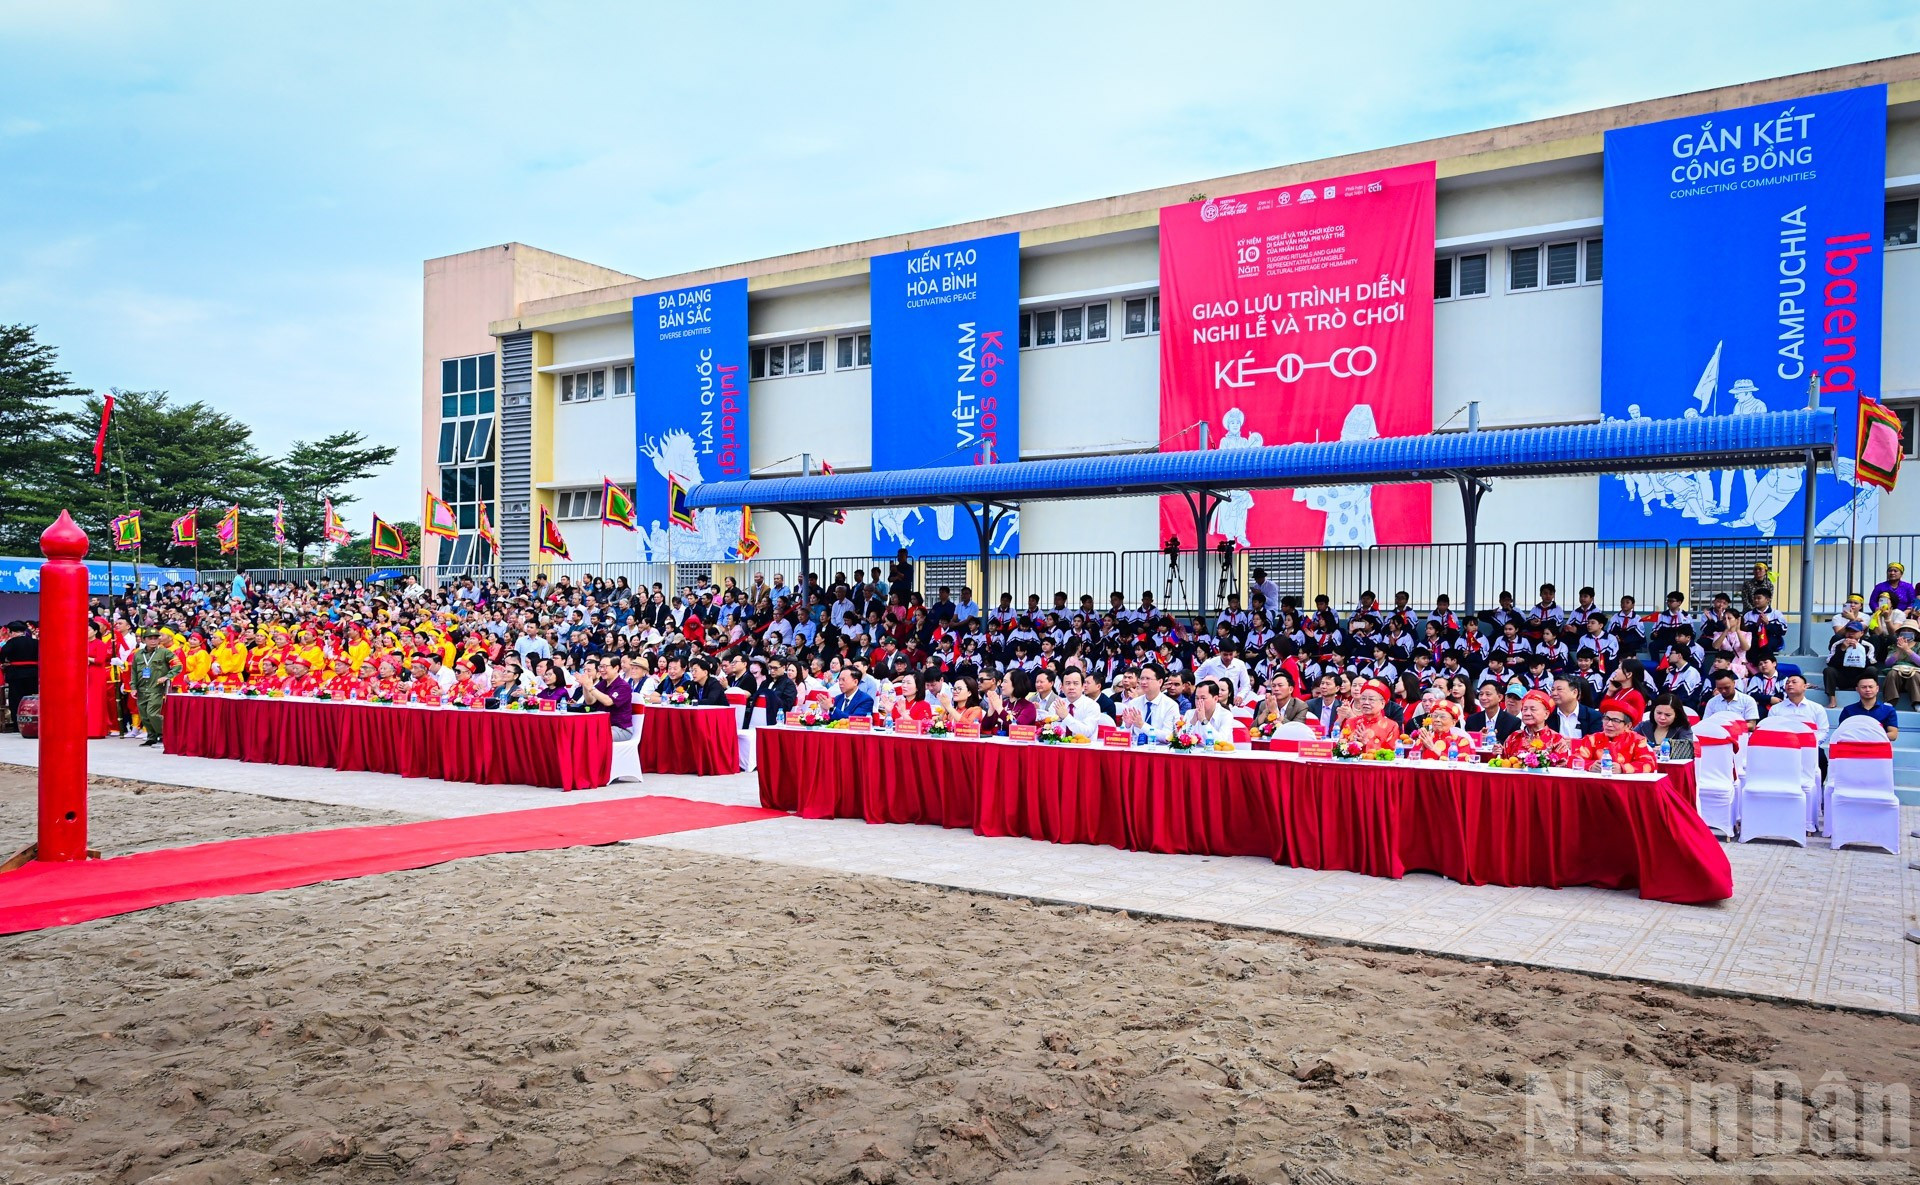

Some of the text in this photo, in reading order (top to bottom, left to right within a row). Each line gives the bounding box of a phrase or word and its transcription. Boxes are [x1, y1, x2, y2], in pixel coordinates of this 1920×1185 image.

[1672, 106, 1816, 159] GẮN KẾT
[1671, 145, 1813, 185] CỘNG ĐỒNG
[1669, 170, 1817, 199] CONNECTING COMMUNITIES
[907, 248, 977, 275] KIẾN TẠO
[1237, 246, 1260, 265] 10
[1266, 267, 1293, 276] CULTURAL
[1294, 263, 1320, 272] HERITAGE
[1329, 258, 1359, 268] HUMANITY
[1290, 251, 1313, 260] RITUALS
[1313, 249, 1325, 257] AND
[1326, 247, 1346, 255] GAMES
[1238, 264, 1260, 275] Năm
[907, 272, 977, 297] HÒA BÌNH
[1192, 273, 1406, 321] GIAO LƯU TRÌNH DIỄN
[1777, 205, 1807, 380] CAMPUCHIA
[658, 288, 712, 310] ĐA DẠNG
[906, 291, 977, 309] CULTIVATING PEACE
[659, 303, 712, 329] BẢN SẮC
[1193, 304, 1405, 344] NGHI LỄ VÀ TRÒ CHƠI
[659, 326, 712, 341] DIVERSE IDENTITIES
[981, 330, 1004, 387] Kéo
[952, 321, 979, 450] VIỆT NAM
[696, 347, 714, 455] HÀN QUỐC
[716, 363, 741, 475] Juldarigi
